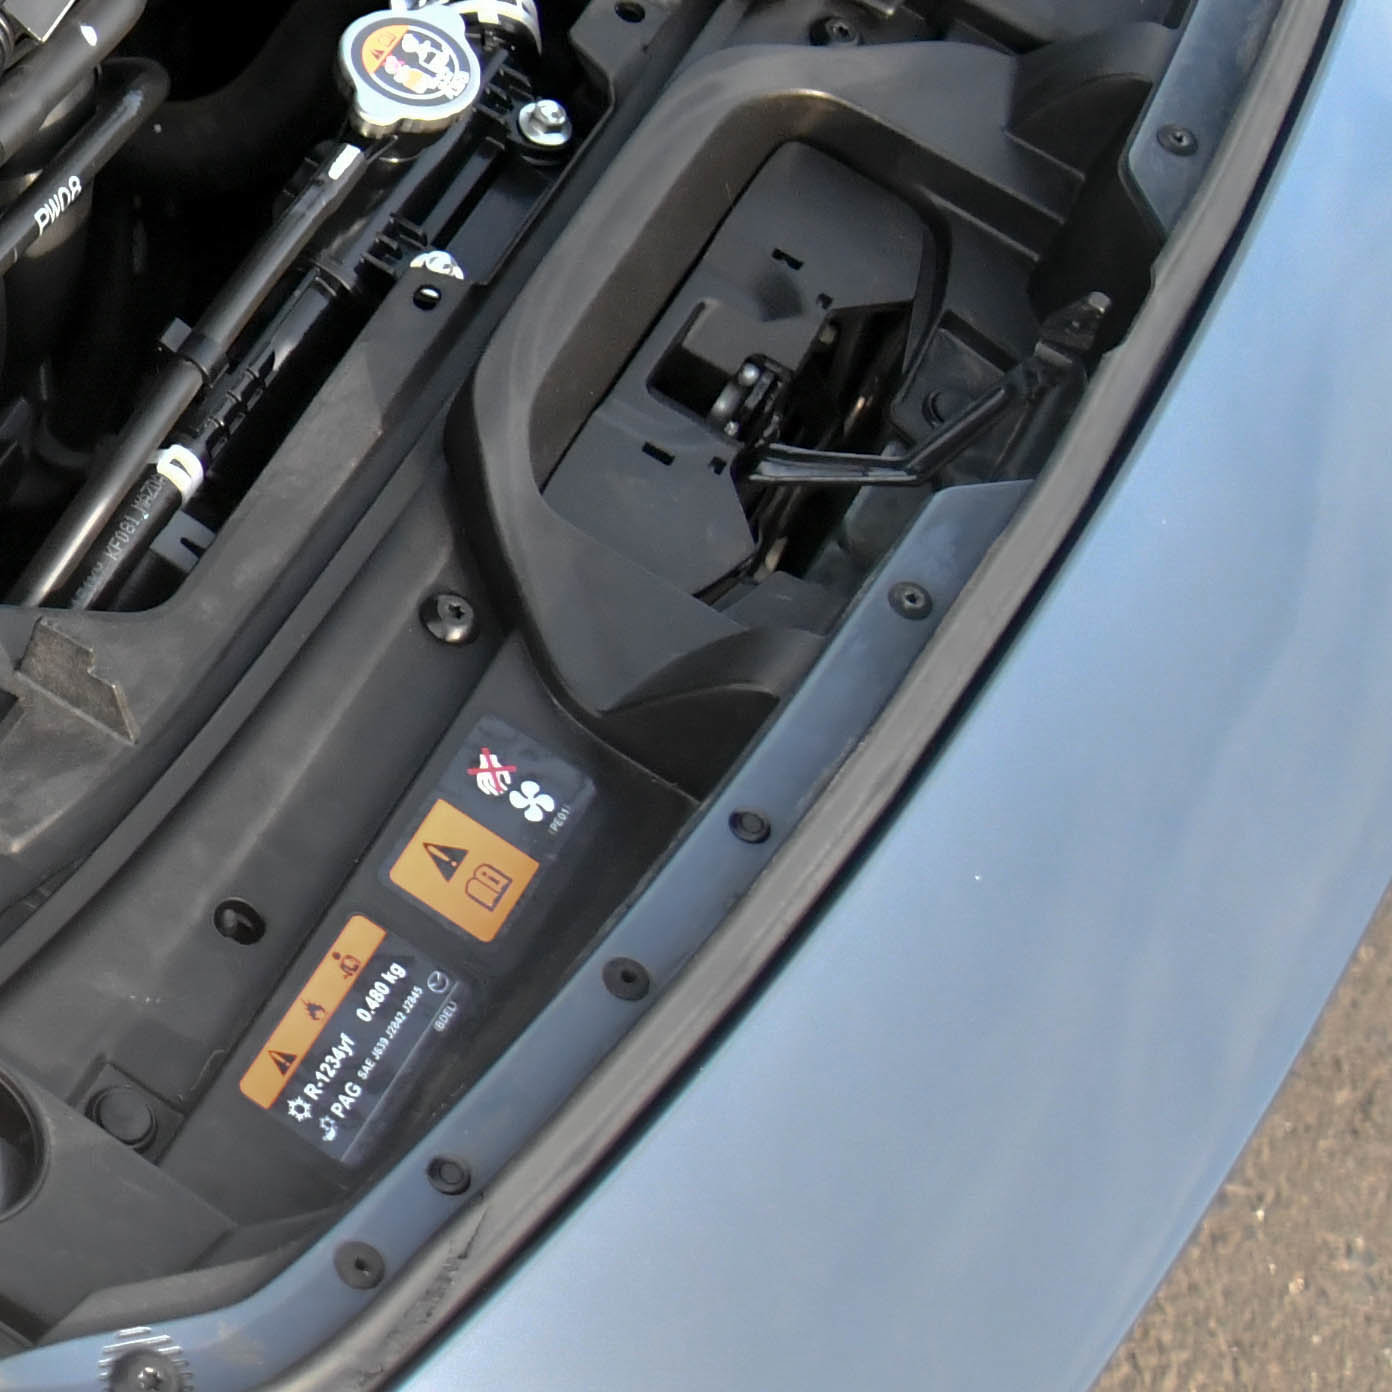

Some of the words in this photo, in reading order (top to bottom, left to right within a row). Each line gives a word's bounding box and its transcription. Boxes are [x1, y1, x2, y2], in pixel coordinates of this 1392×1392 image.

[304, 1032, 355, 1100] R-1234yf
[356, 981, 390, 1022] 0.480
[381, 962, 407, 984] kg
[330, 1082, 362, 1118] PAG
[357, 1058, 377, 1080] SAE
[372, 1037, 389, 1060] J639
